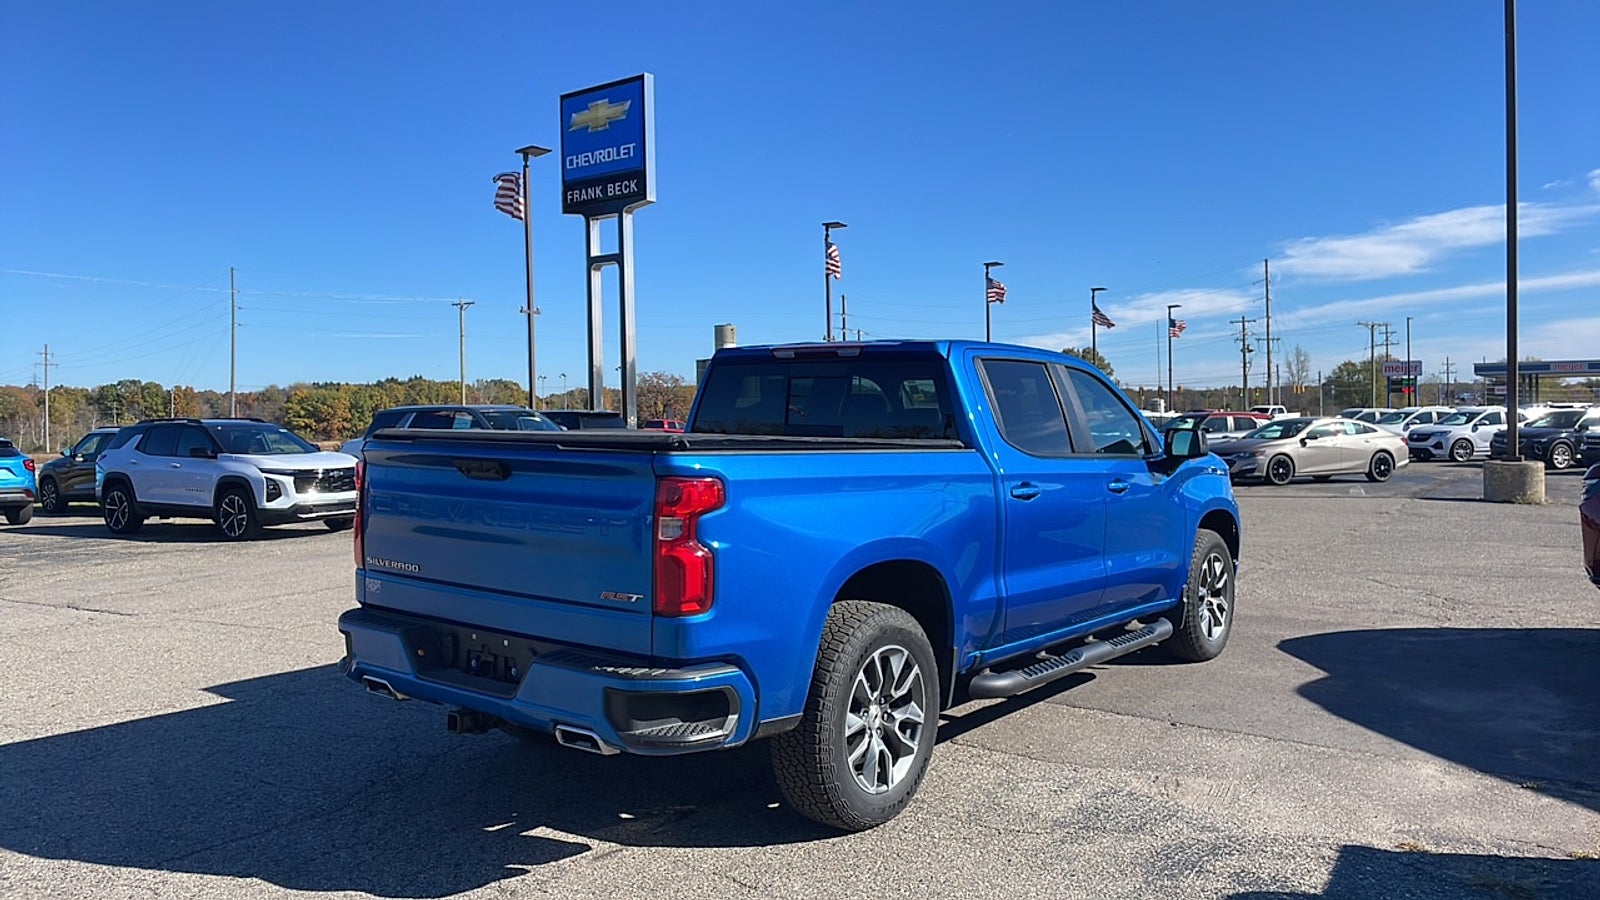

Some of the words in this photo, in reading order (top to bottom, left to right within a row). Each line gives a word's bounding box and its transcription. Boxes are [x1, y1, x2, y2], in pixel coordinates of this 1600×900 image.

[566, 142, 636, 169] CHEVROLET
[567, 185, 603, 204] FRANK
[607, 179, 638, 197] BECK
[366, 556, 419, 573] SILVERADO
